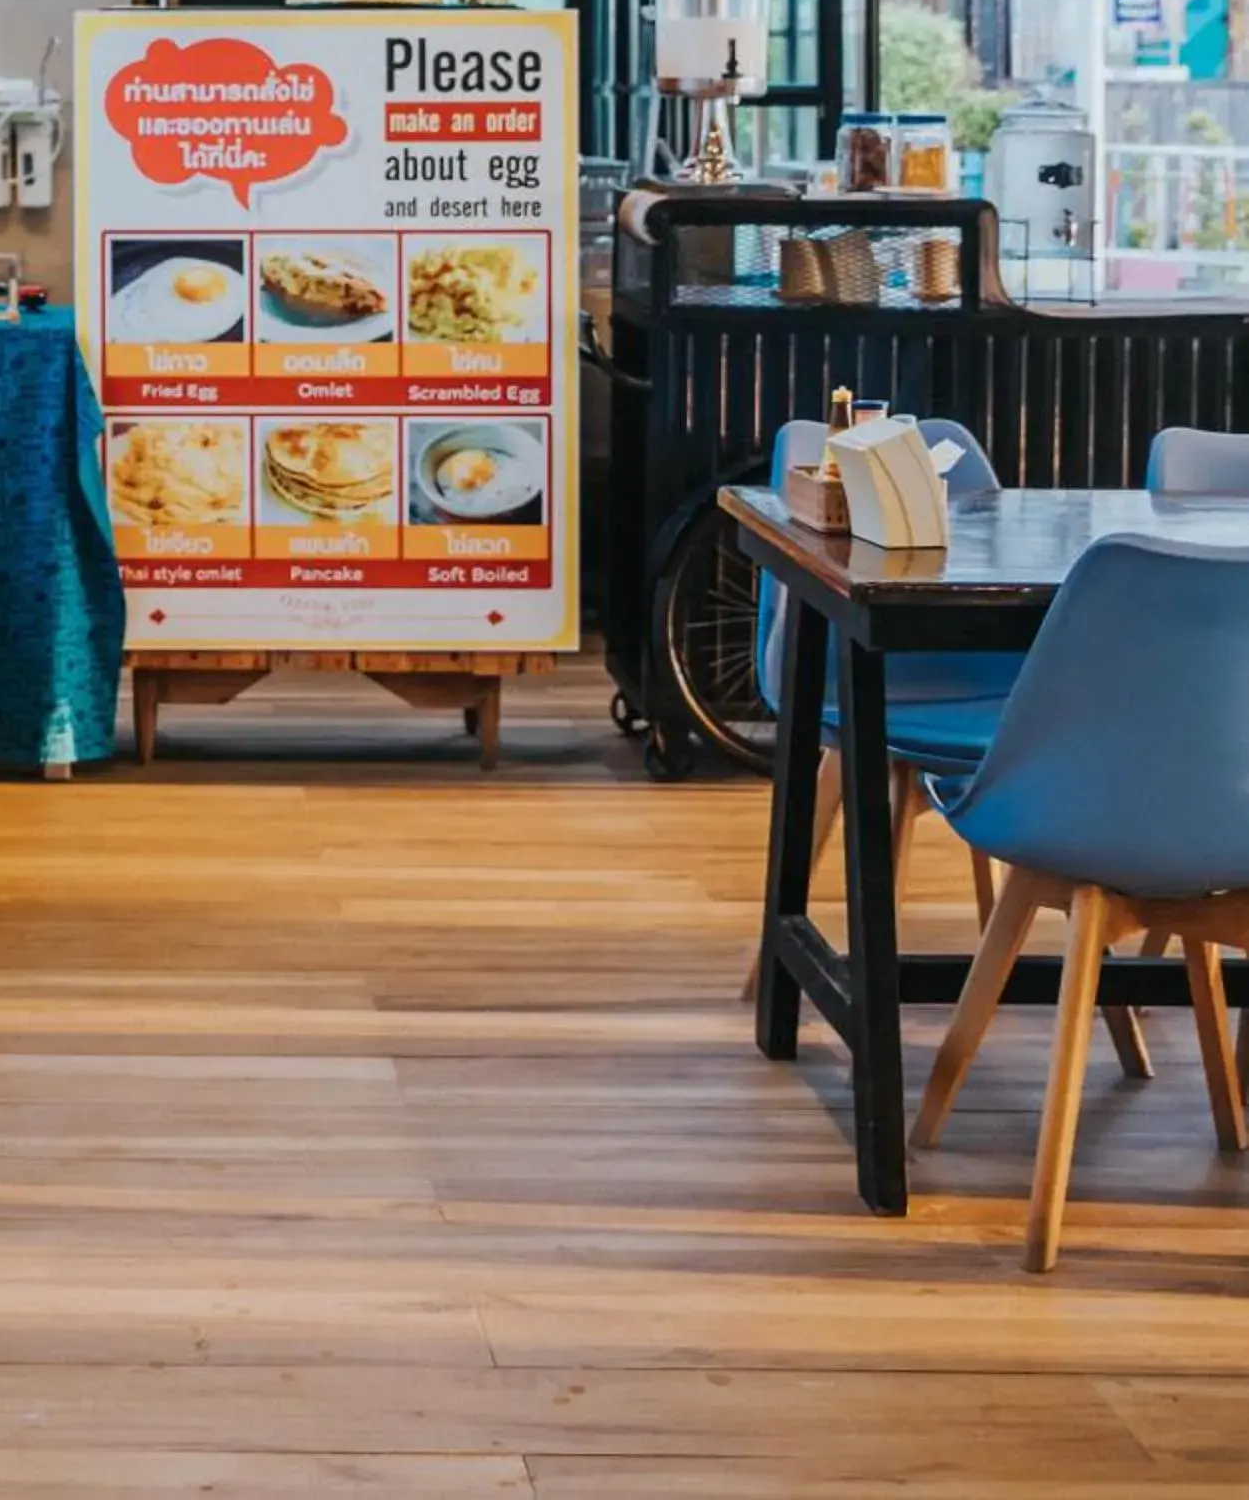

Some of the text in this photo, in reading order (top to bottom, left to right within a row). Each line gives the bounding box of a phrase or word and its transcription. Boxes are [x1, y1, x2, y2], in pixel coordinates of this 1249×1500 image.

[386, 37, 542, 93] Please
[389, 107, 537, 133] make an order
[385, 148, 540, 189] about egg
[385, 196, 542, 217] and desert here
[141, 383, 219, 402] Fried Egg
[298, 381, 354, 399] Omlet
[408, 385, 541, 404] Scrambled Egg
[153, 565, 192, 586] style
[195, 565, 242, 581] omlet
[290, 565, 363, 581] Pancake
[428, 566, 529, 582] Soft Boiled
